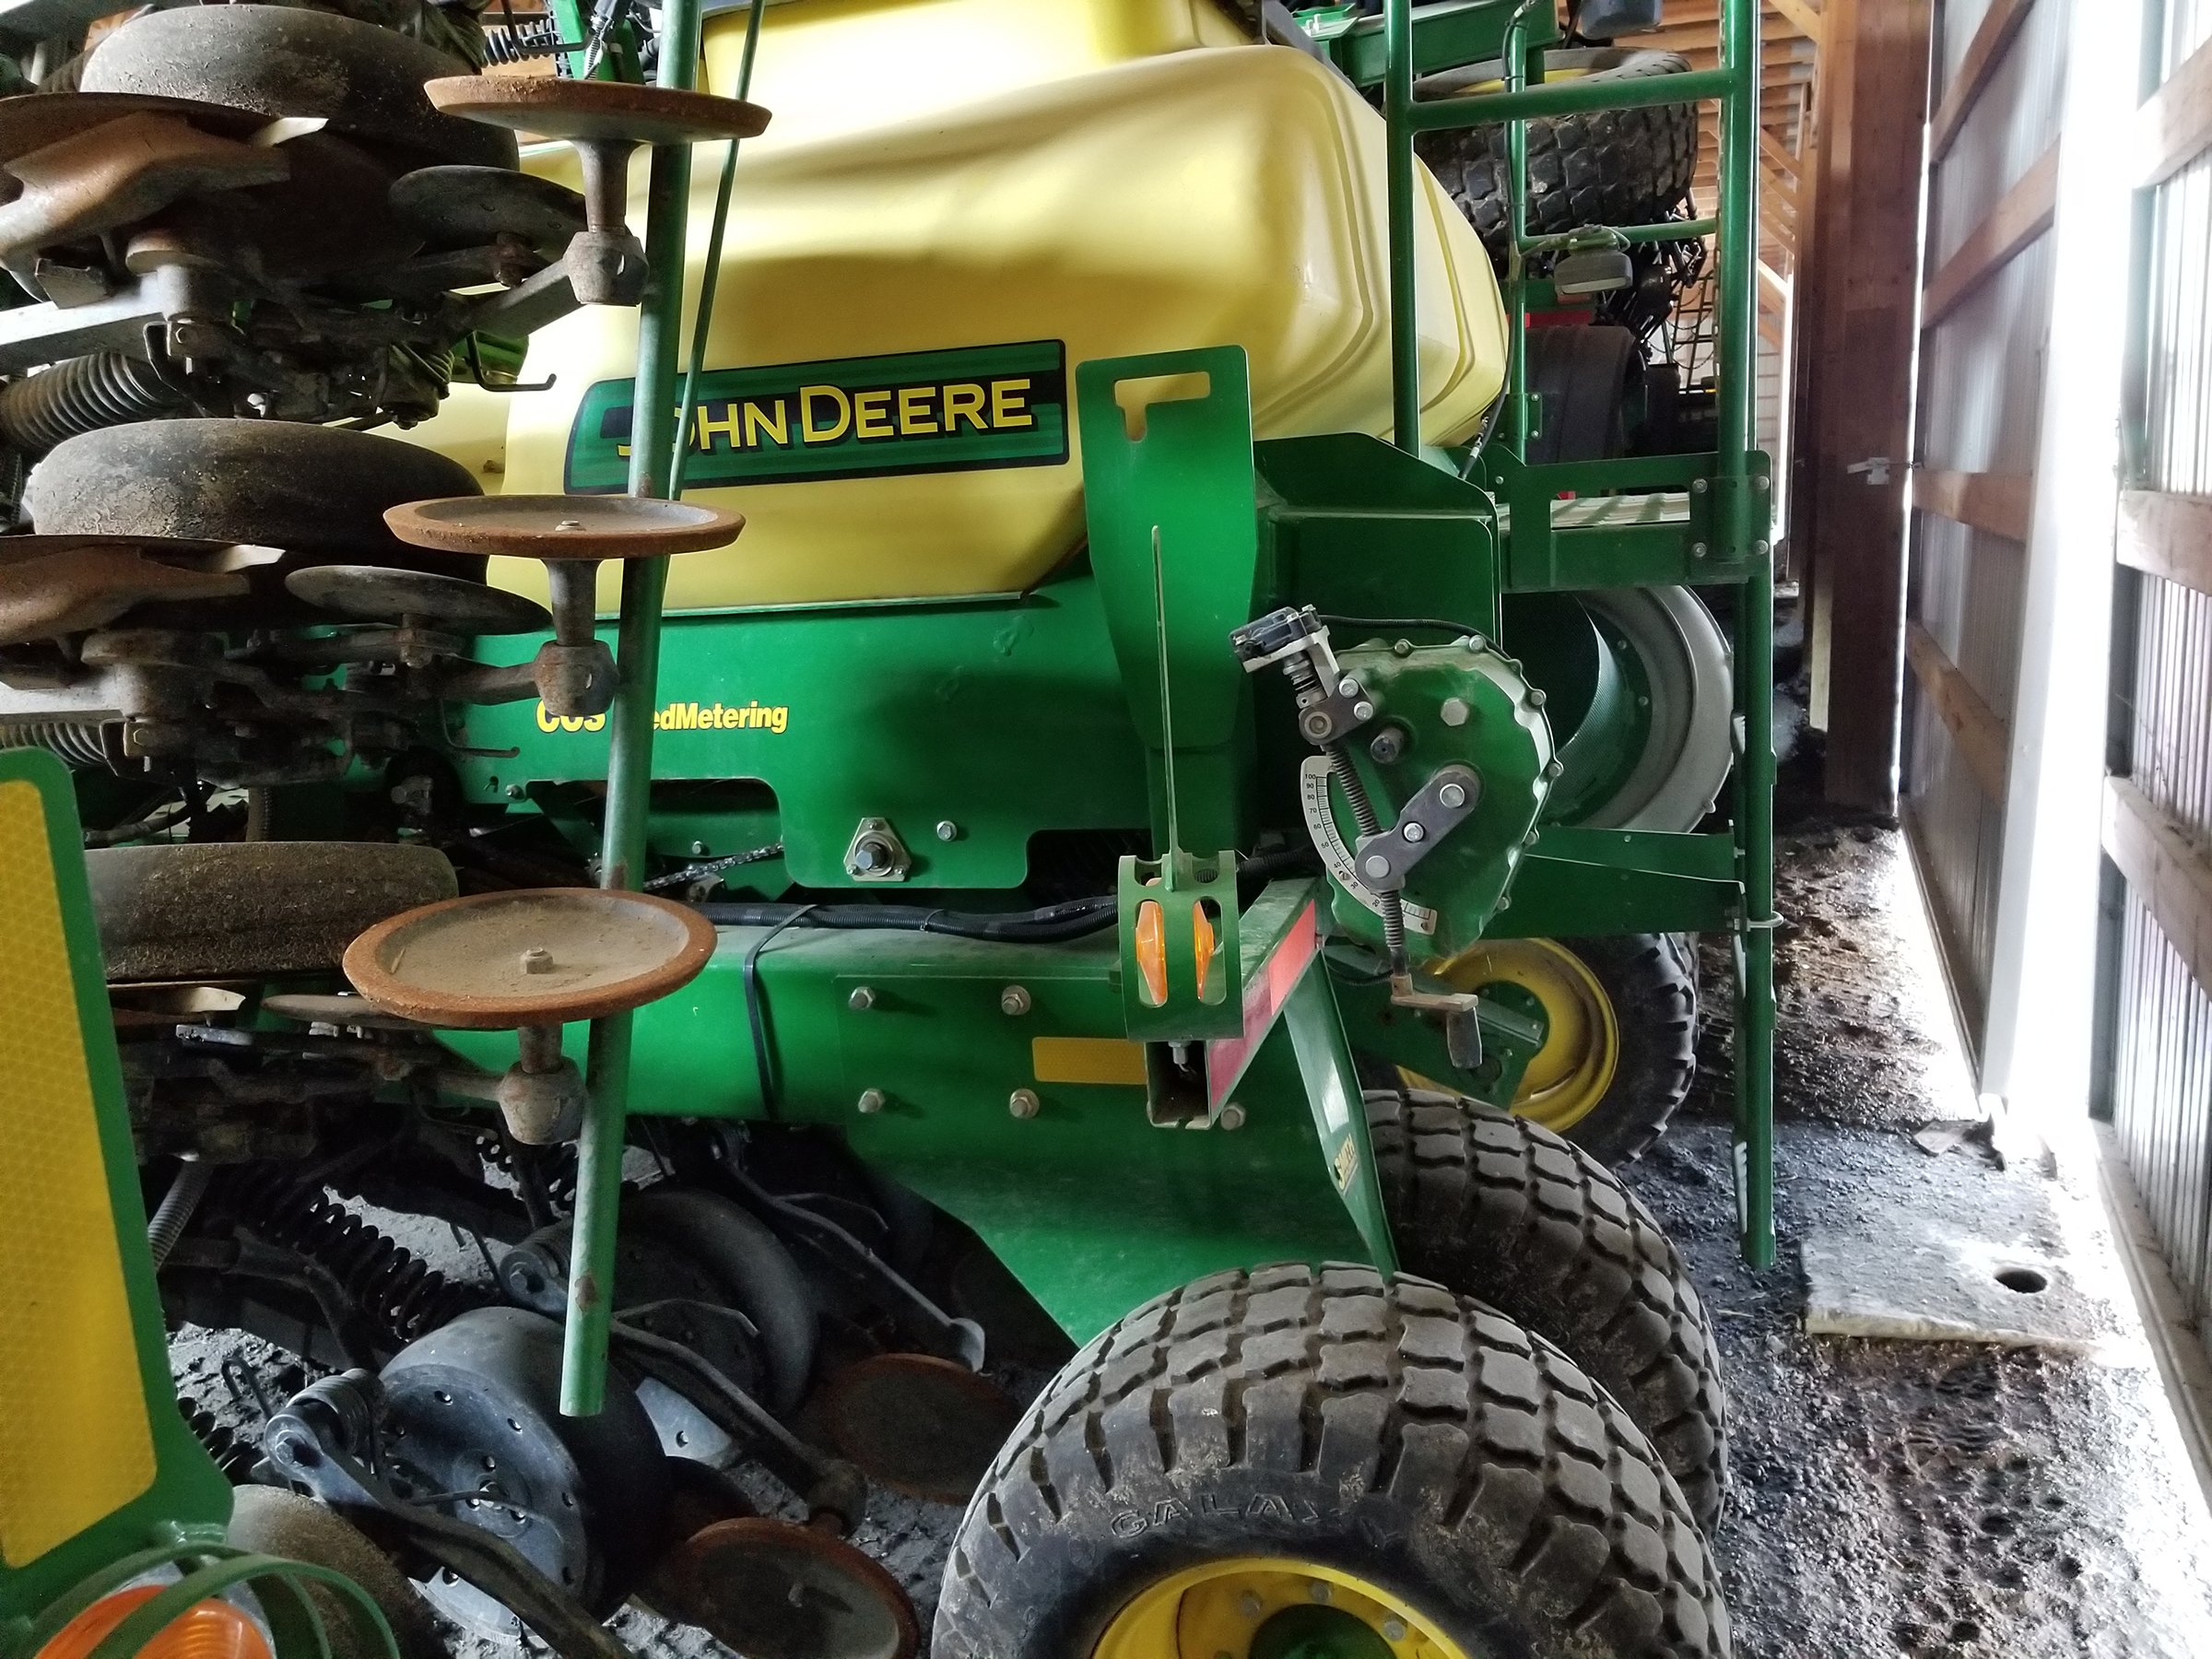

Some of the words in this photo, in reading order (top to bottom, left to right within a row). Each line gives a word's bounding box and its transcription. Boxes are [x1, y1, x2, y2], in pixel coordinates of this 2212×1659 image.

[618, 399, 788, 457] HN
[800, 379, 1032, 443] DEERE
[653, 700, 788, 734] dMetering
[1350, 881, 1359, 889] 30
[1371, 899, 1381, 908] 20
[1110, 1493, 1406, 1547] GALA
